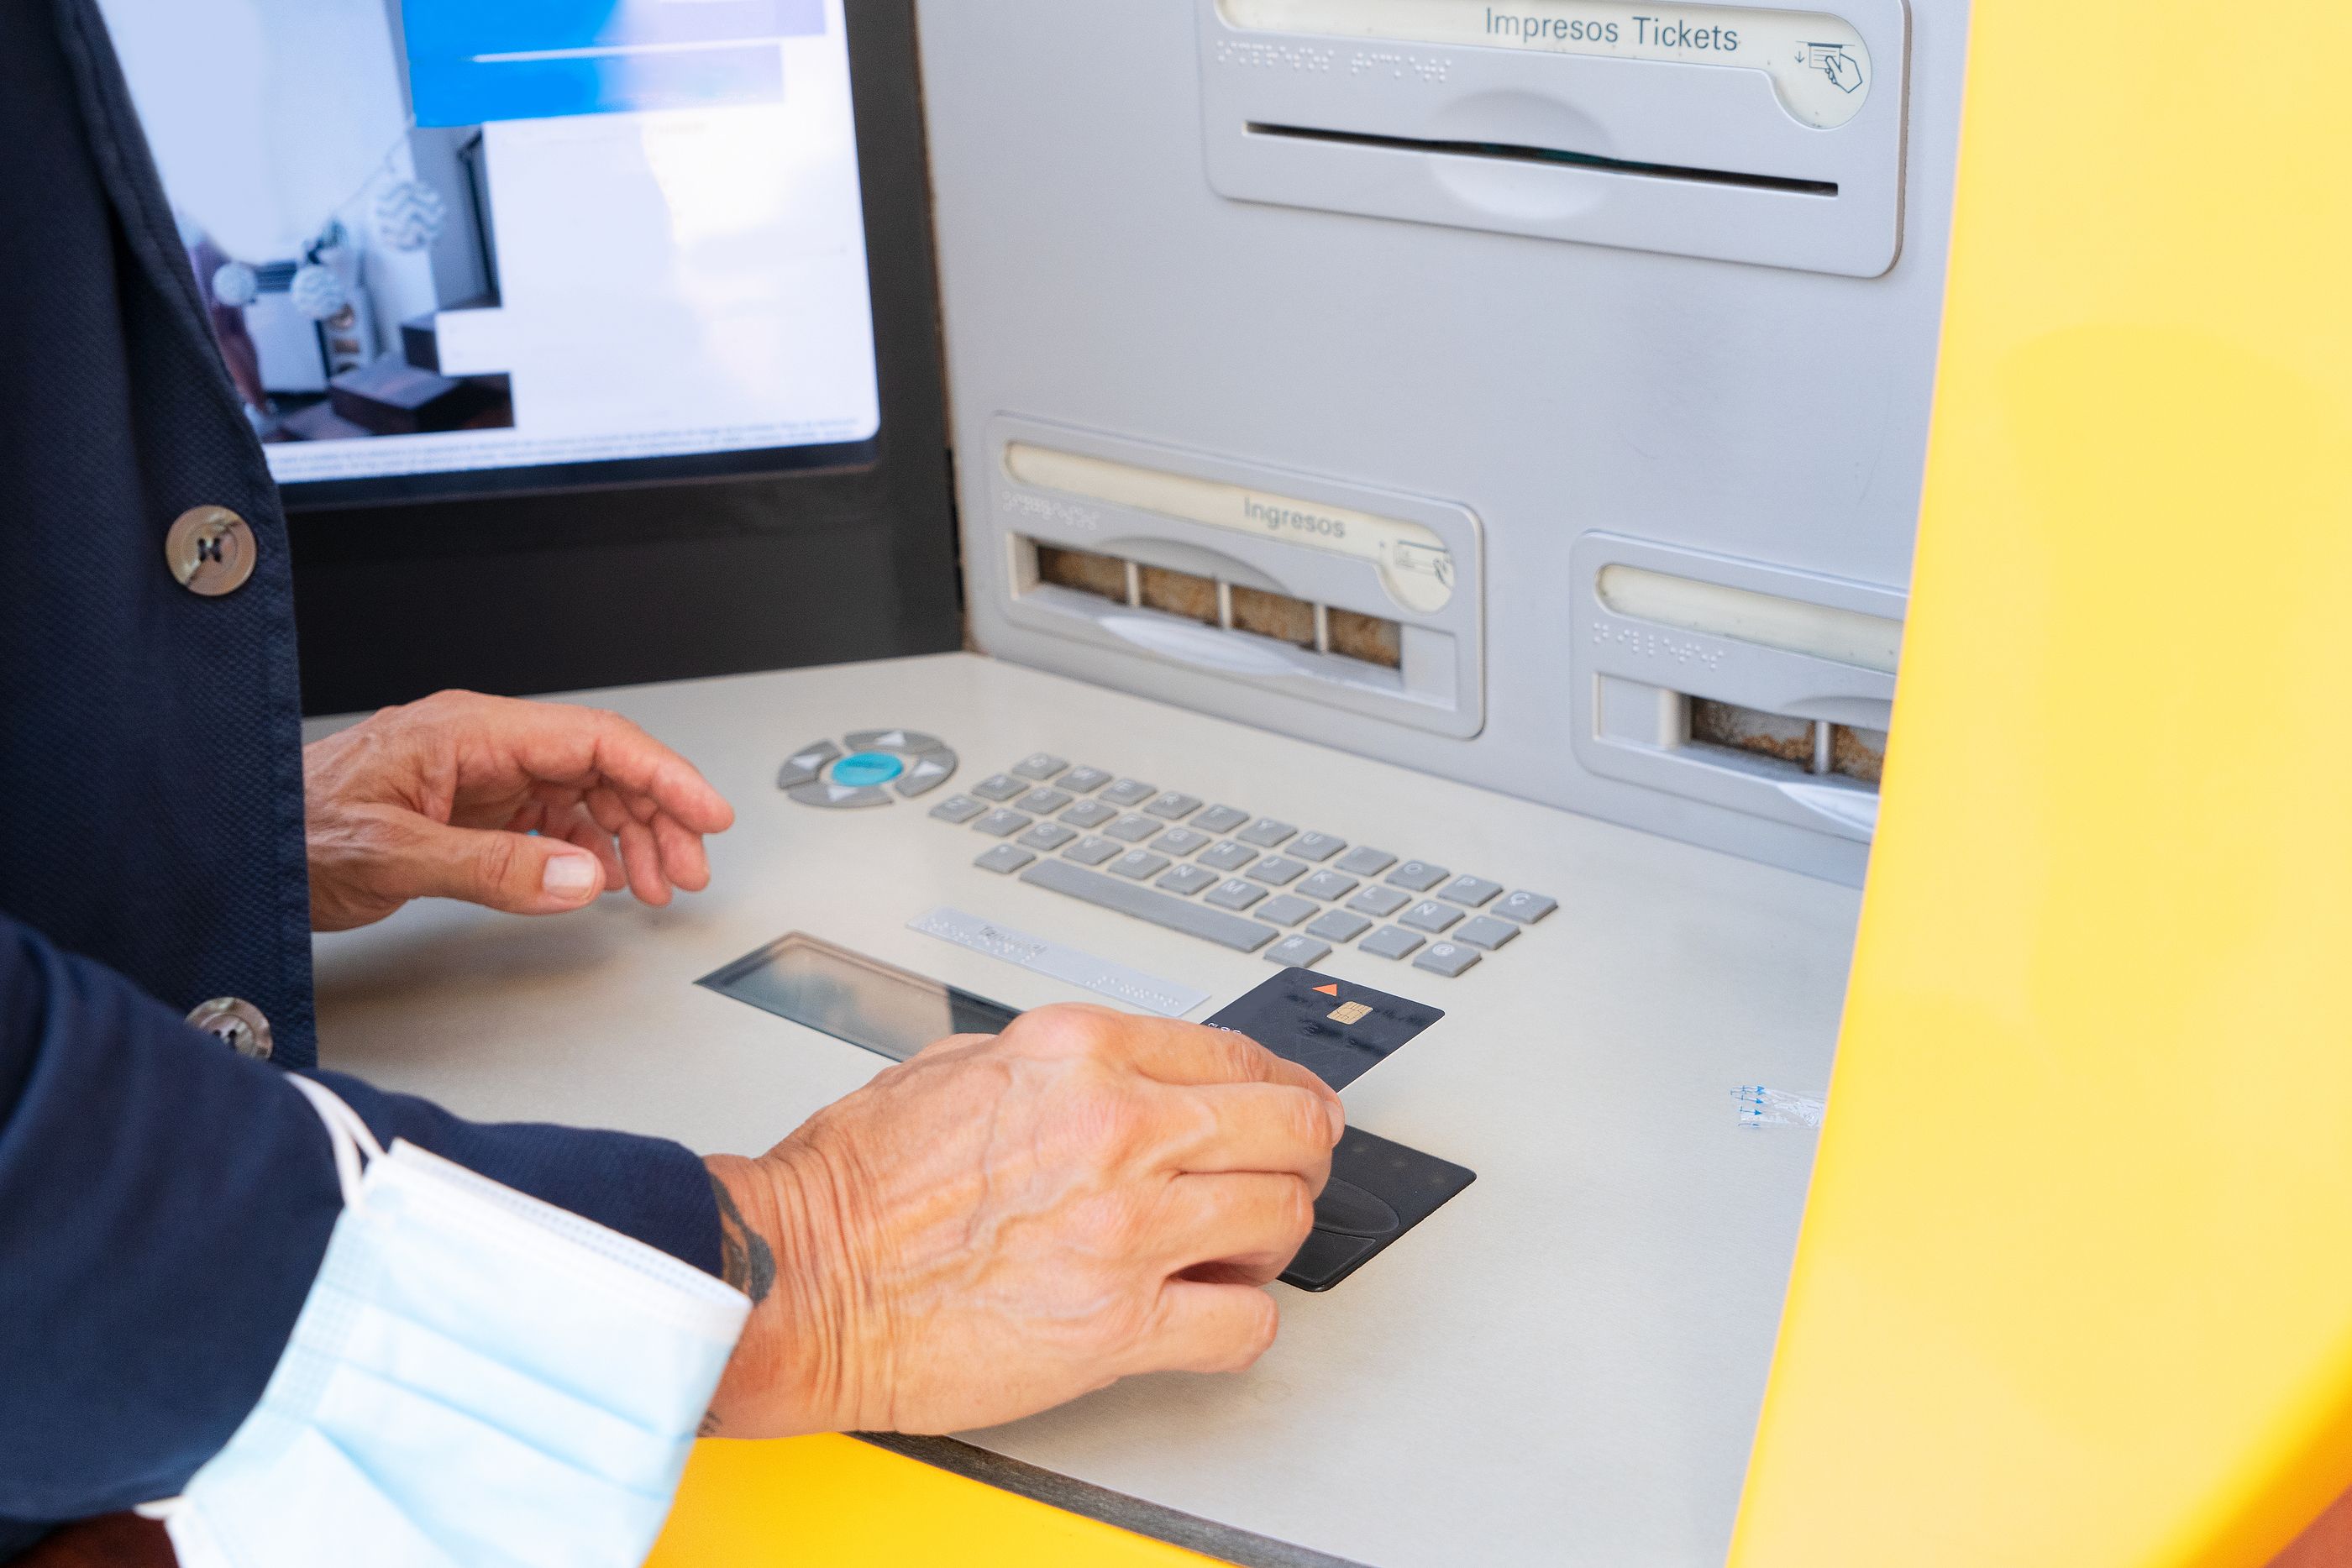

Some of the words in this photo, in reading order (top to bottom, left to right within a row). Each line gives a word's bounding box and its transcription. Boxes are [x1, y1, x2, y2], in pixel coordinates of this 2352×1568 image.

[1485, 8, 1618, 43] Impresos
[1632, 16, 1738, 51] Tickets
[1244, 496, 1346, 538] Ingresos
